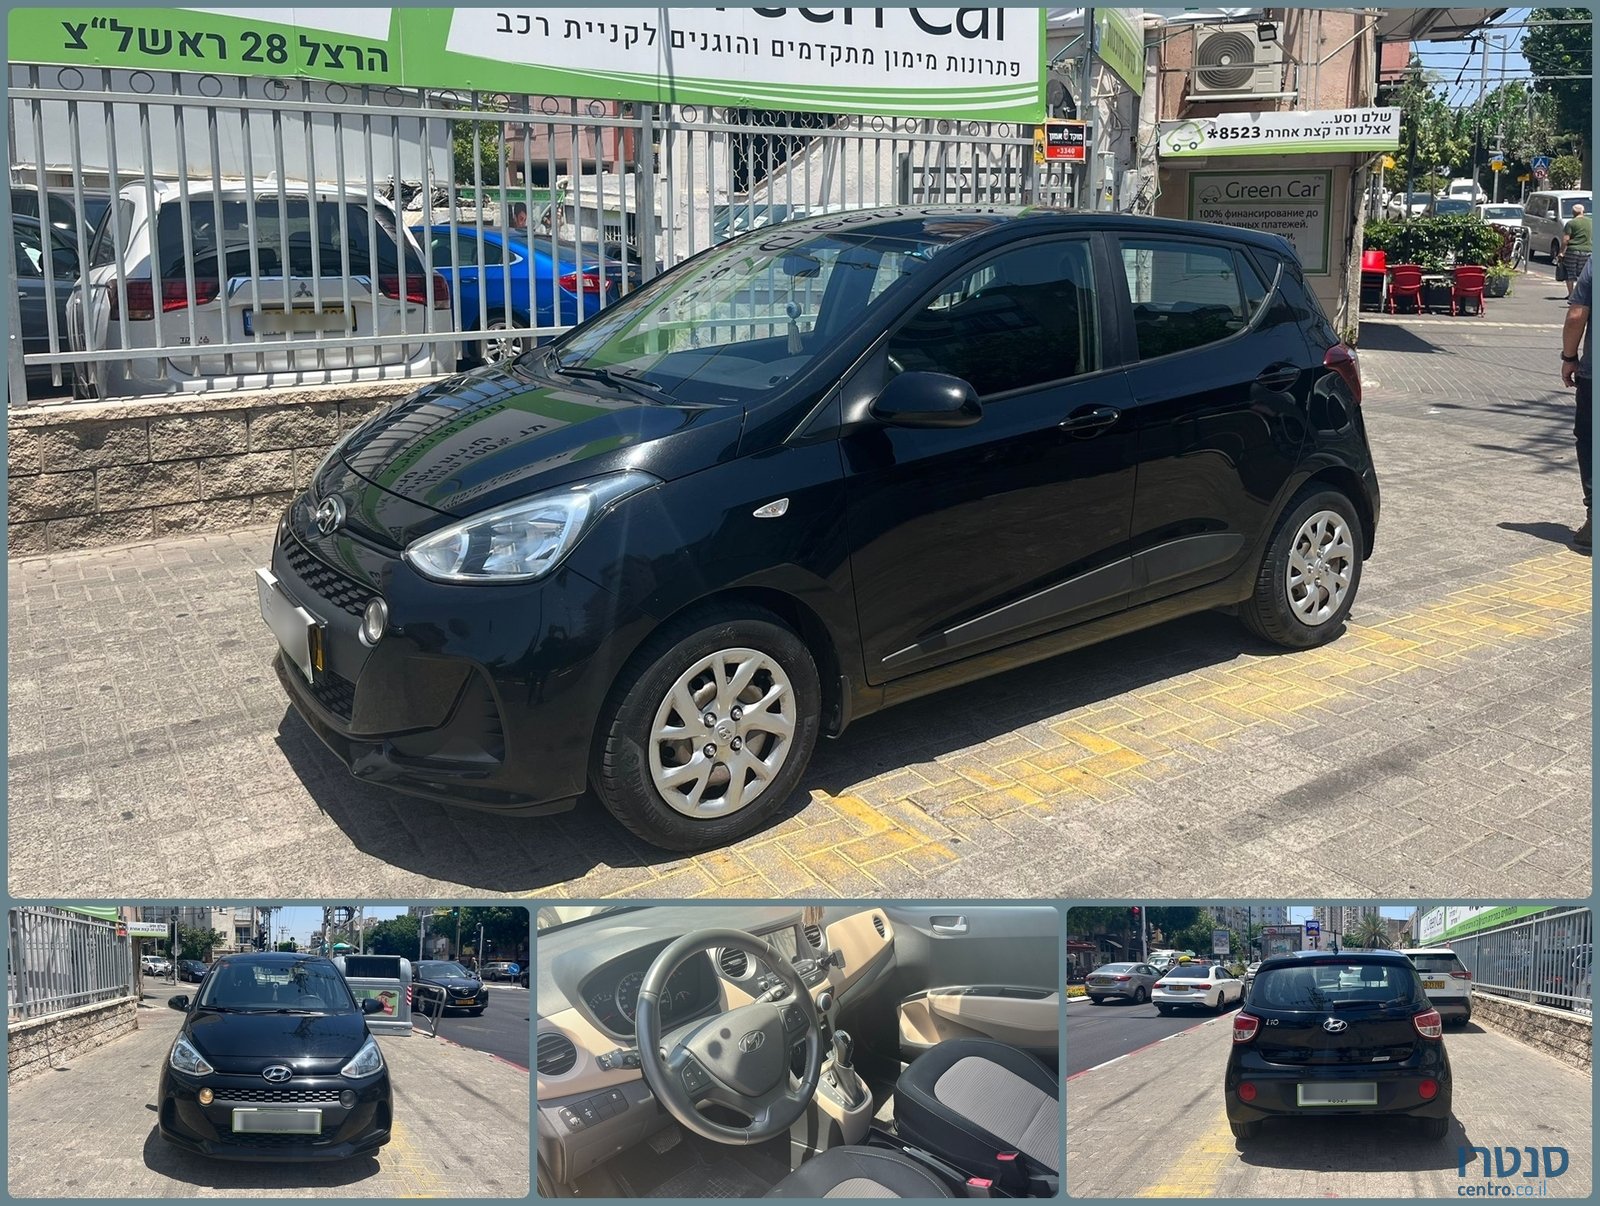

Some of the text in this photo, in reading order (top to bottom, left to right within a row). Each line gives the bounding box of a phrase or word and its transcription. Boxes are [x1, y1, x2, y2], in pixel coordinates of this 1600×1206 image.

[239, 31, 289, 65] 28
[496, 12, 1021, 77] פתרונות מימון מתקדמים והוגנים לקניית רכב
[299, 34, 389, 72] הרצל
[1321, 112, 1392, 124] שלם וסע...
[1264, 128, 1299, 138] אחרת
[1303, 126, 1331, 139] קצת
[1335, 126, 1350, 136] זה
[1354, 124, 1391, 135] אצלנו
[1225, 180, 1320, 199] Green Car
[1199, 209, 1319, 220] 100% финансирование до
[1261, 219, 1309, 229] платежей.
